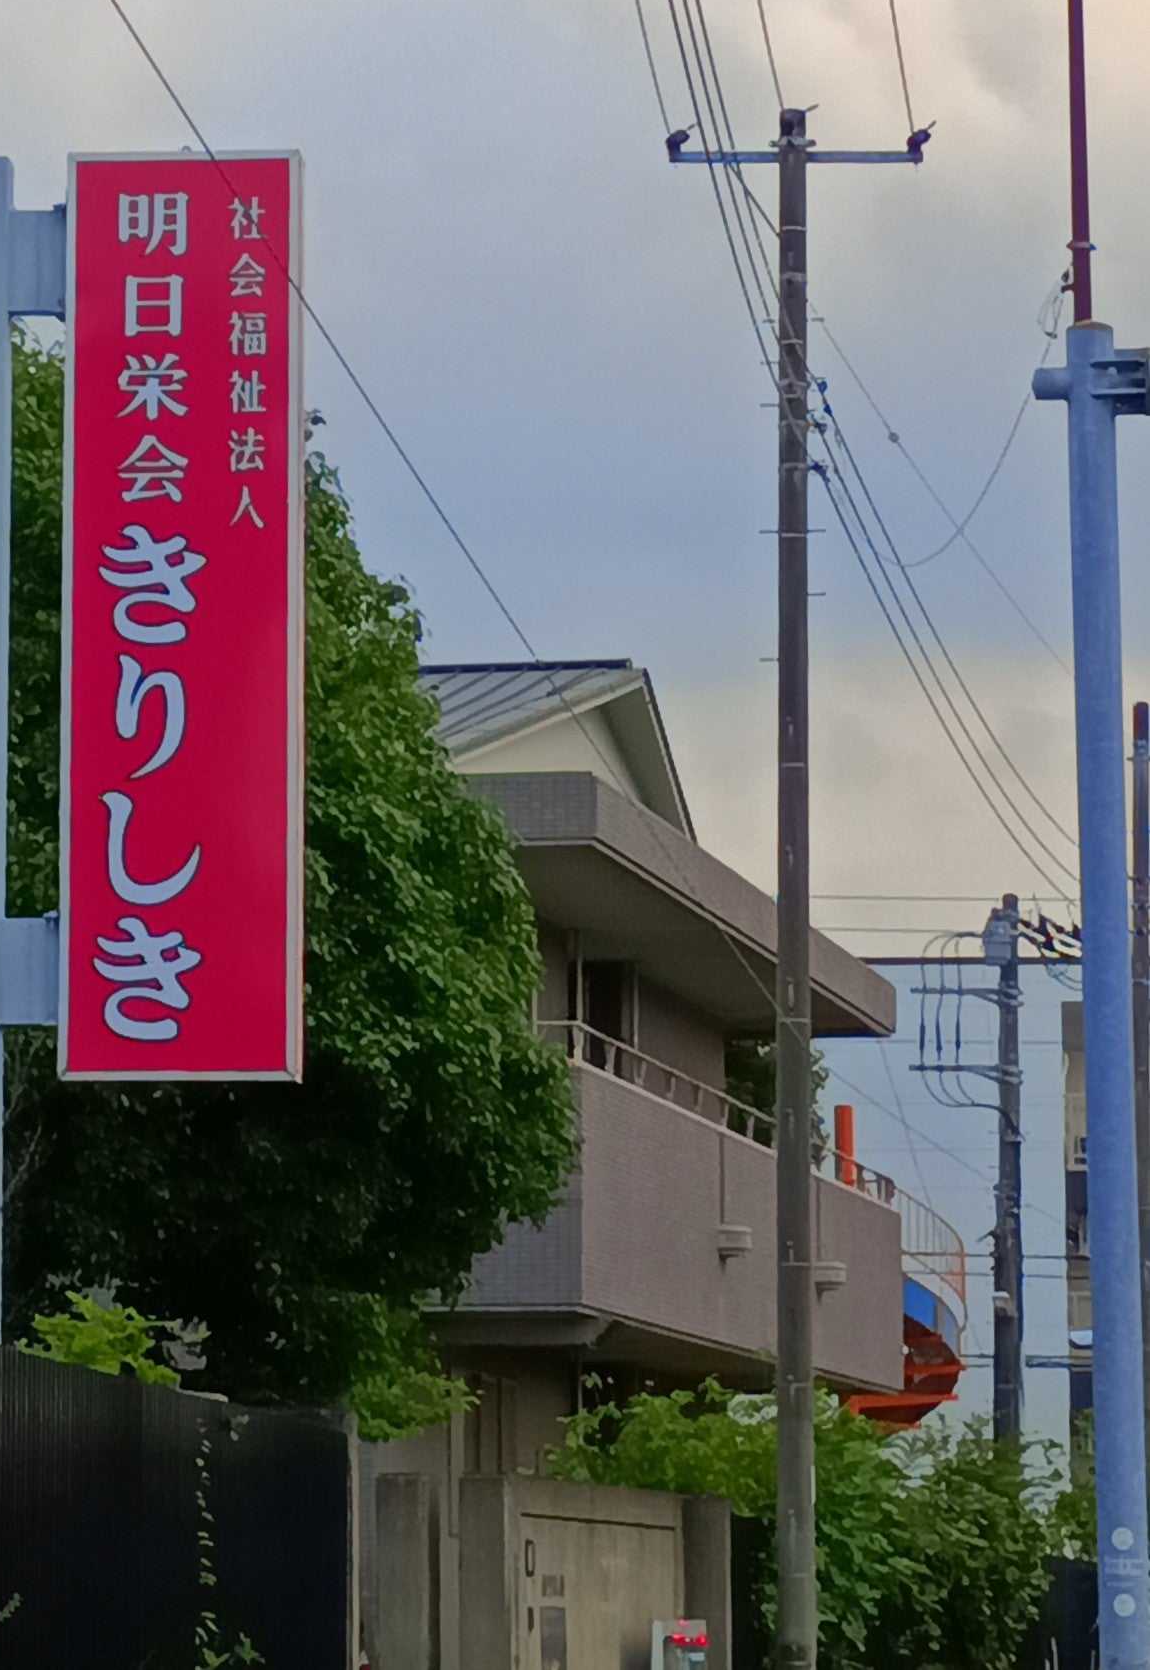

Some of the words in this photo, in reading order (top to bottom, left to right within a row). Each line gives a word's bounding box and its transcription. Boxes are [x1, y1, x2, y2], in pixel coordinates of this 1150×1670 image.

[227, 196, 267, 529] 社会福祉法人
